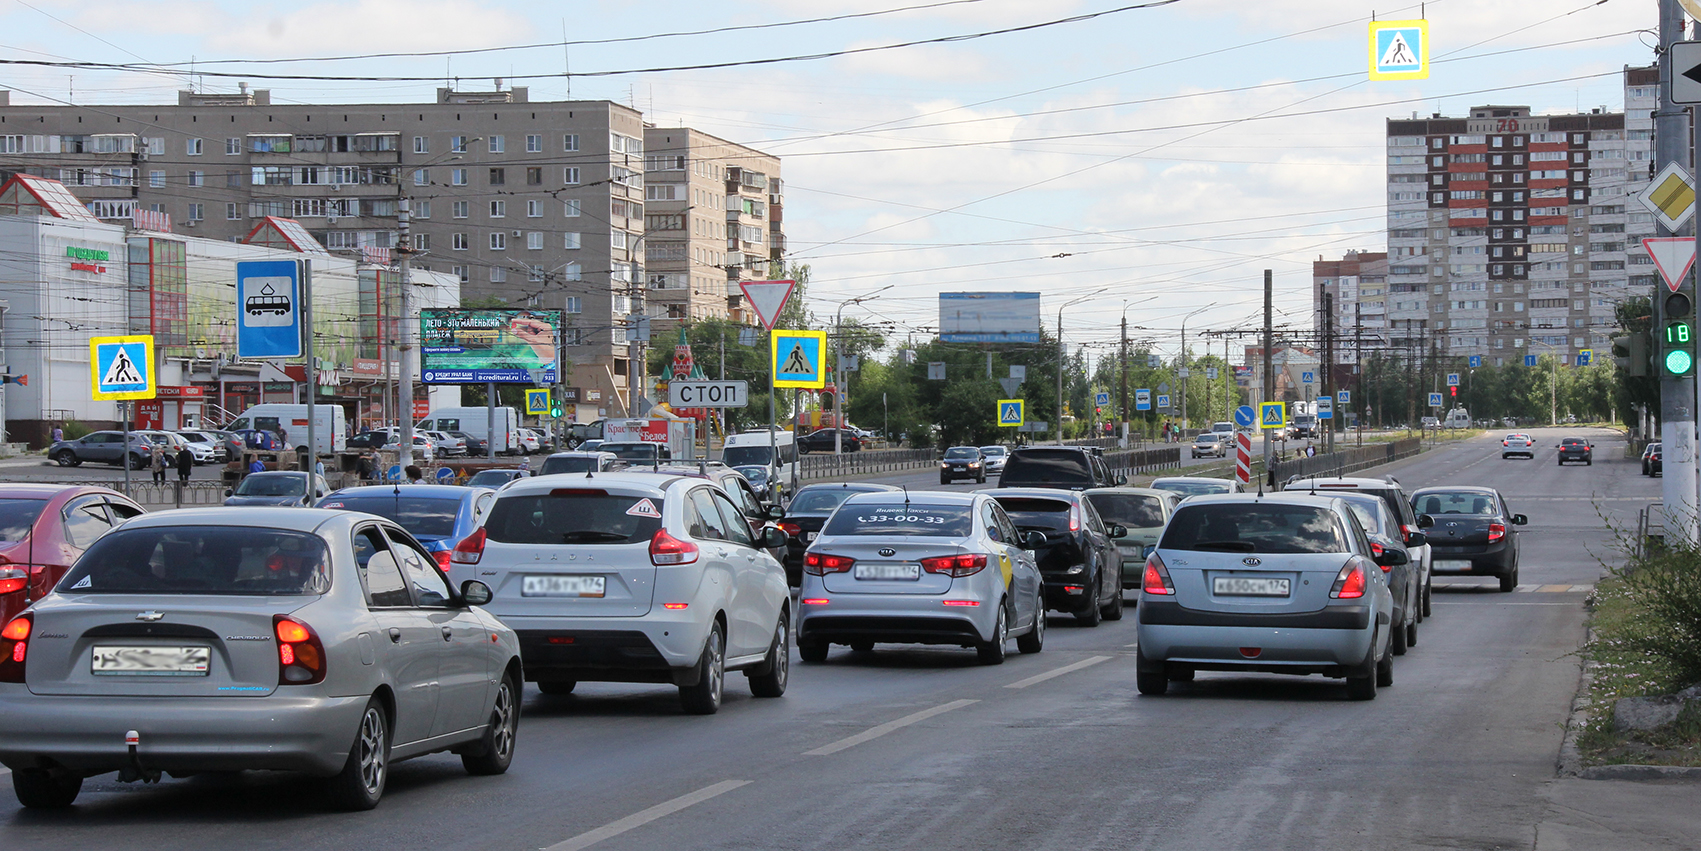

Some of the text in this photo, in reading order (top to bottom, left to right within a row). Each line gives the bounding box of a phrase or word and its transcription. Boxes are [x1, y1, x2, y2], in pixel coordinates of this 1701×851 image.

[1497, 118, 1518, 133] 70
[425, 319, 442, 327] ЛЕТО
[447, 319, 460, 327] ЭТО
[460, 318, 500, 327] МАЛЕНЬКИЙ
[1667, 325, 1689, 342] 18
[681, 386, 736, 402] СТОП
[607, 424, 639, 436] Красое
[644, 430, 667, 441] Белое
[639, 506, 651, 514] Ш
[868, 515, 945, 524] 33-00-33
[535, 553, 594, 561] LADA
